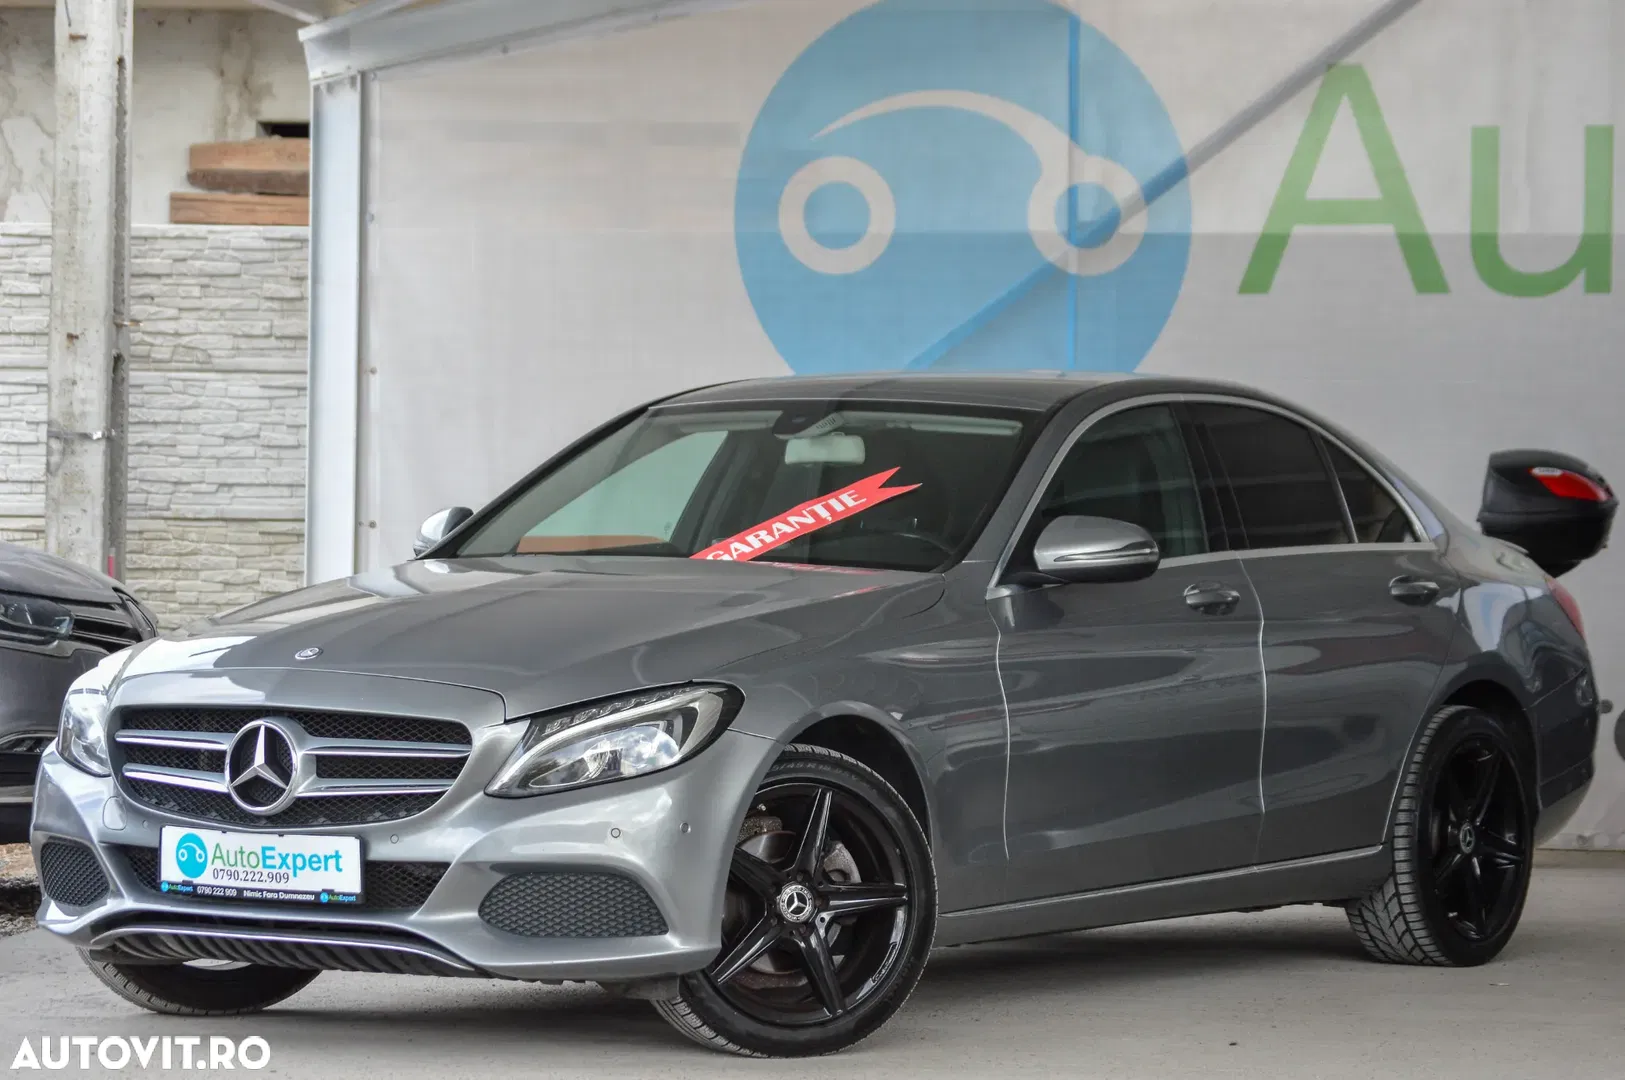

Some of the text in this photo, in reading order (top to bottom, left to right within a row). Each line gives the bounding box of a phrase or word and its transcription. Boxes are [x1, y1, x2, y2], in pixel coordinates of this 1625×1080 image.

[1237, 63, 1614, 297] Au
[211, 842, 343, 878] AutoExpert
[212, 868, 290, 884] 0790.222.909
[168, 884, 194, 892] AutoExpert
[197, 886, 237, 897] 0790 222 909
[243, 890, 262, 898] Nimic
[279, 891, 315, 900] Dumnezeu
[328, 893, 357, 902] AutoExpert
